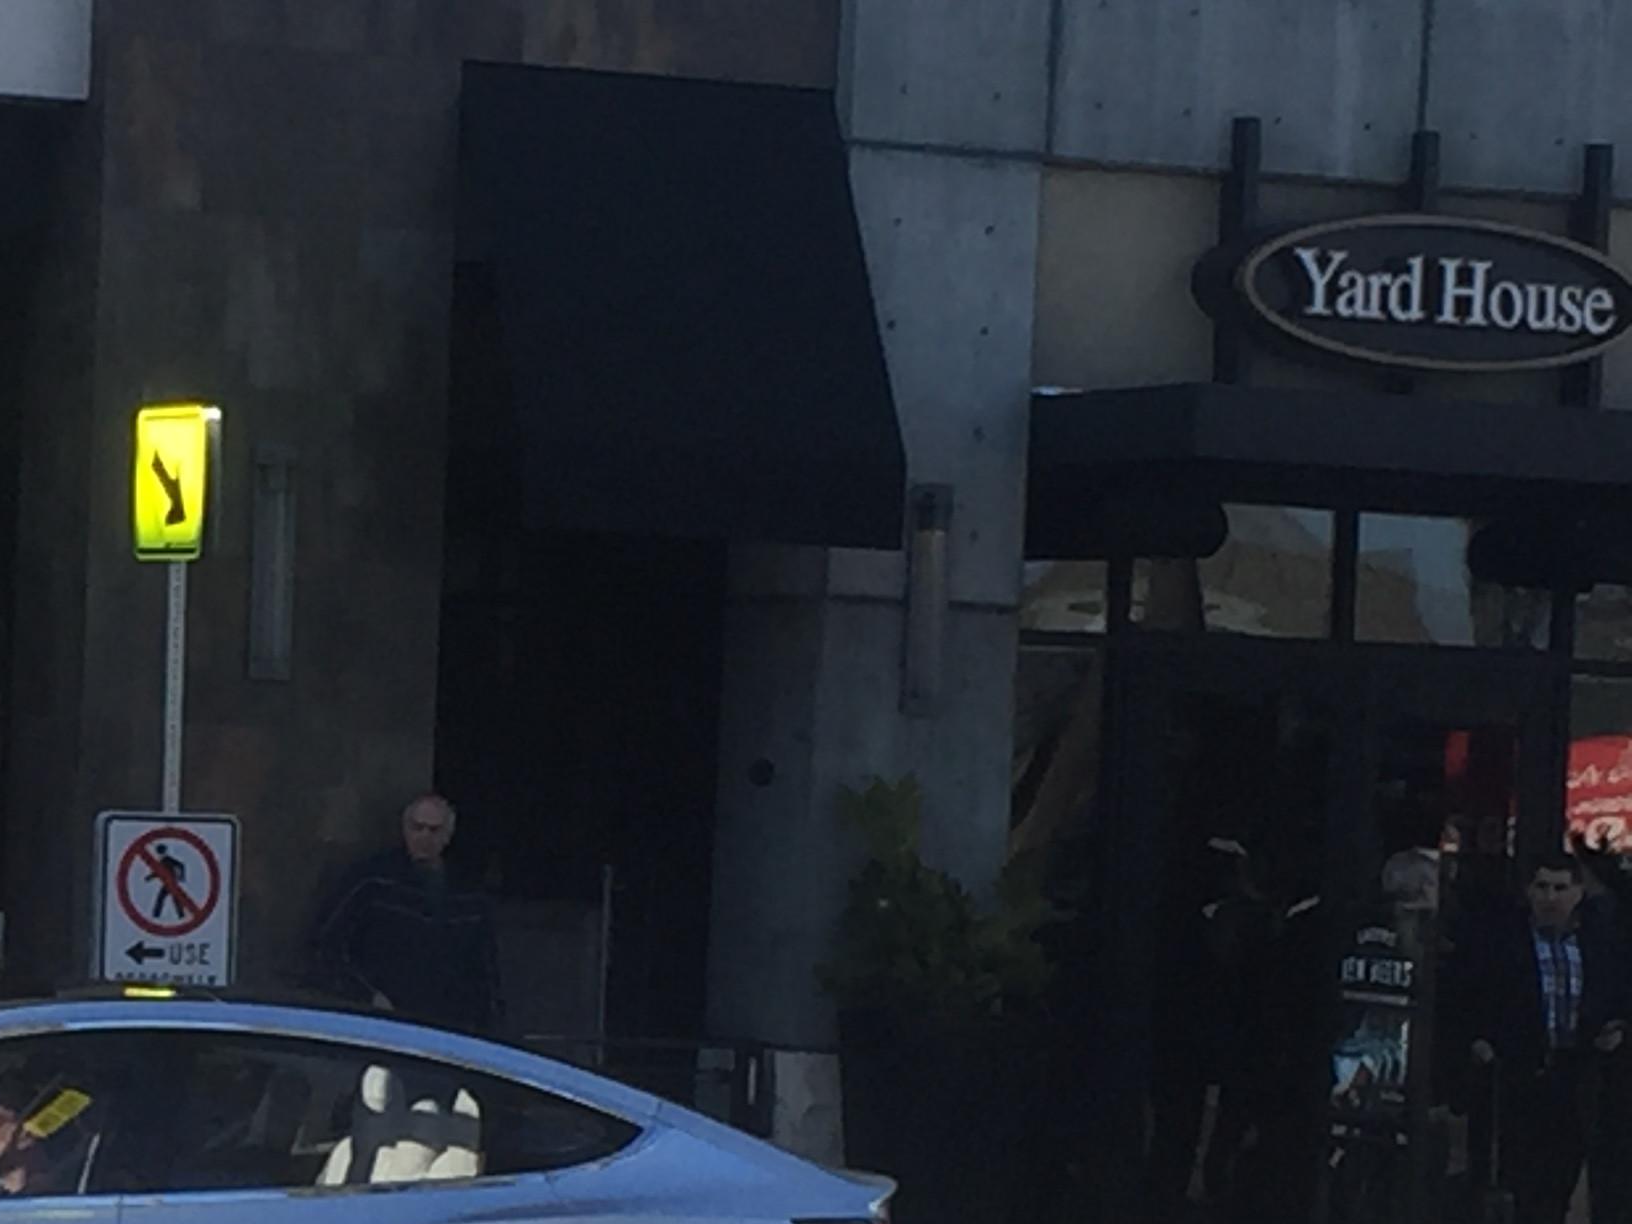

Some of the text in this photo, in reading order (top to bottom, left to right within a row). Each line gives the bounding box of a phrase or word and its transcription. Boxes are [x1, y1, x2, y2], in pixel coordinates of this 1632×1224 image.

[1295, 247, 1615, 334] Yard House
[170, 943, 210, 965] USE
